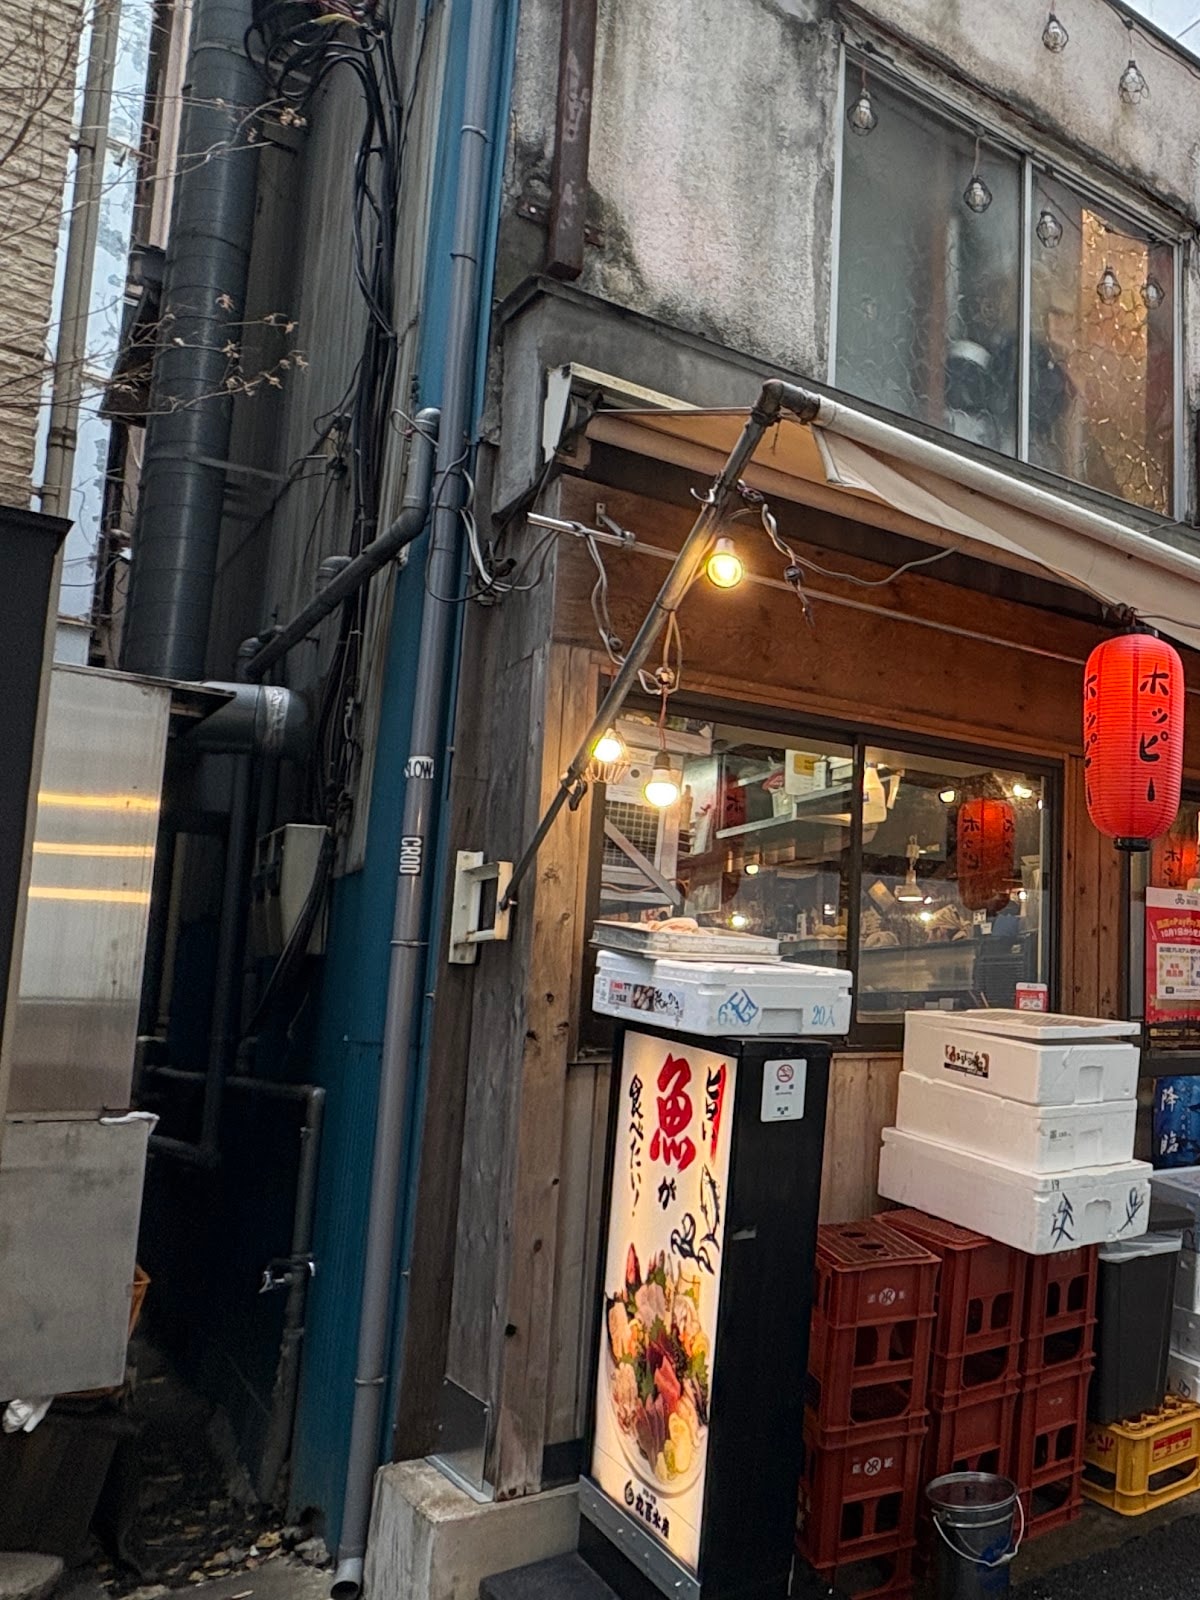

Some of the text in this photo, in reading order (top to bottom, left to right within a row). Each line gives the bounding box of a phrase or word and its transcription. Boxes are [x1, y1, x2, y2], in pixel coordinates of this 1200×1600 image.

[1139, 662, 1170, 803] ホッピー
[1160, 1085, 1180, 1155] 降臨
